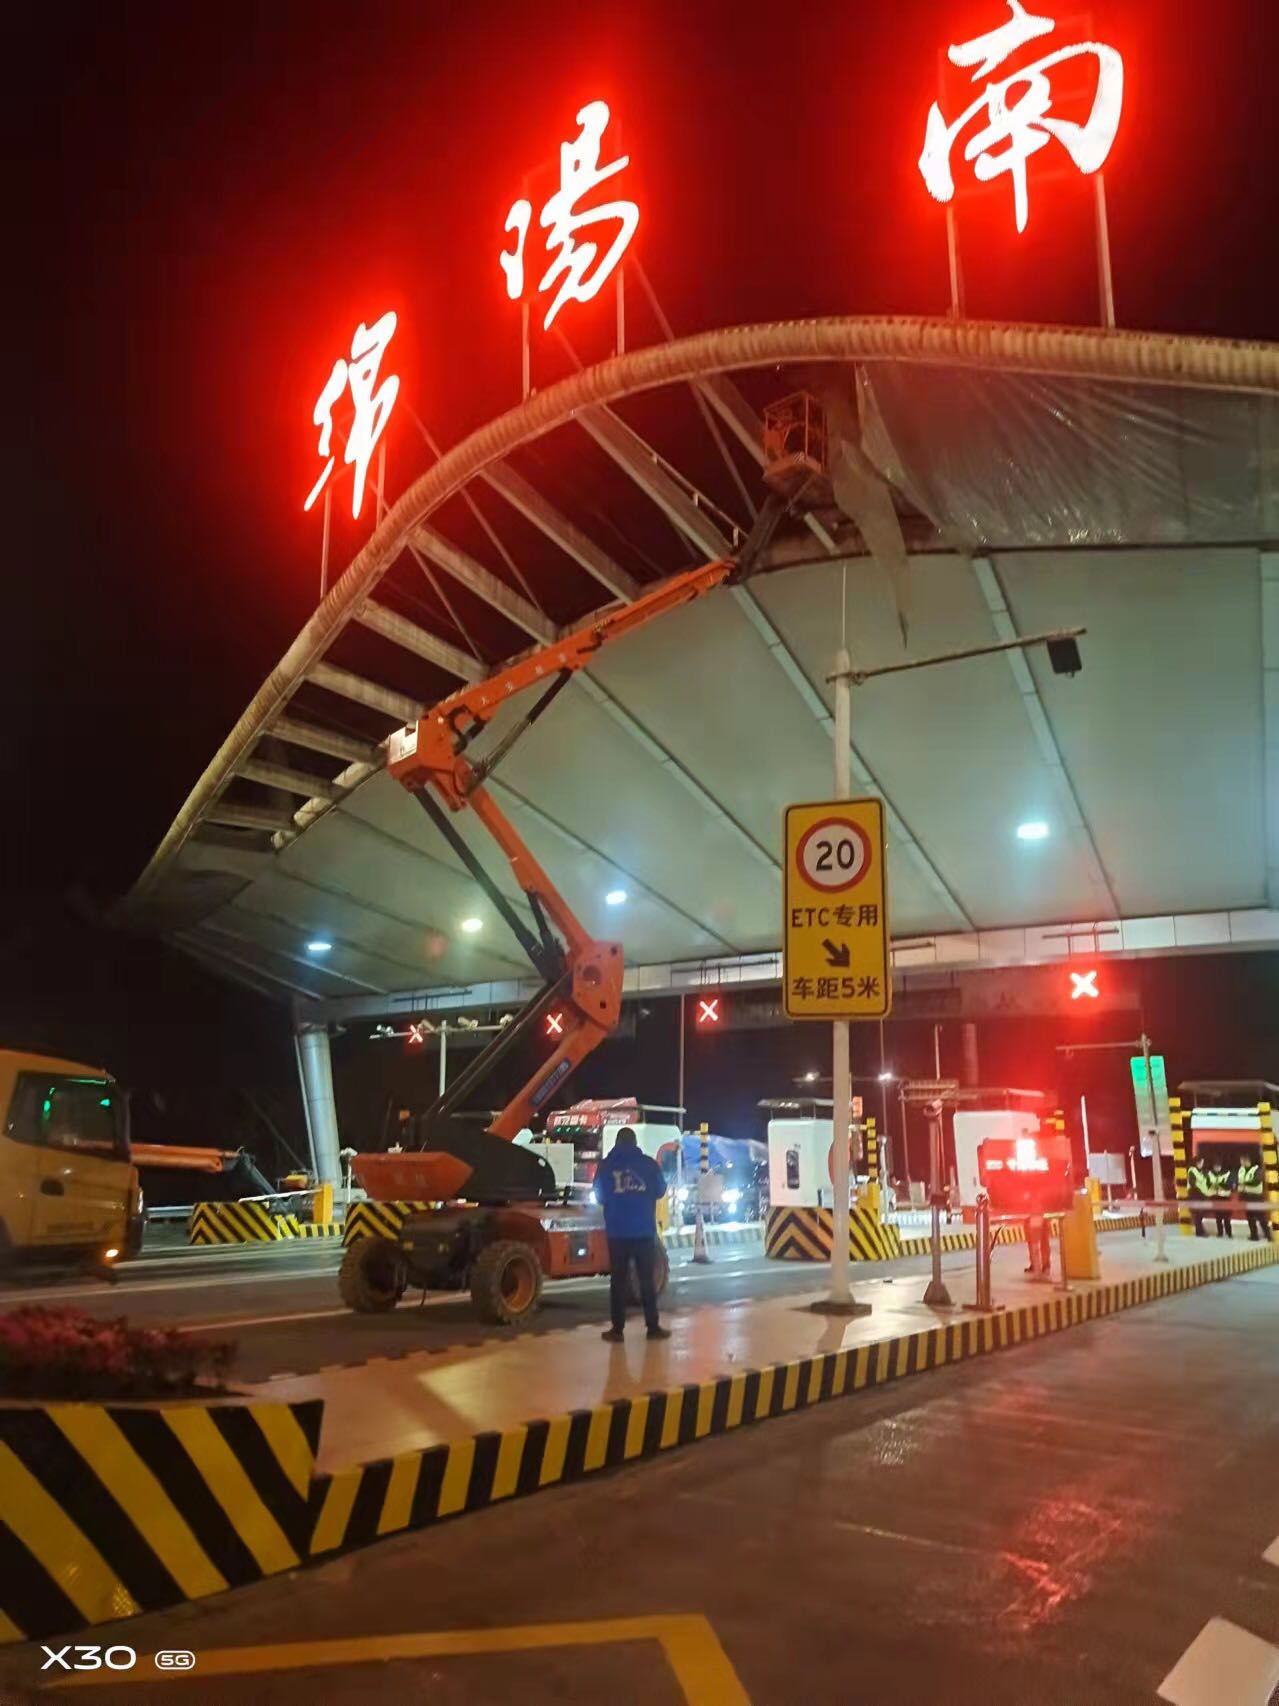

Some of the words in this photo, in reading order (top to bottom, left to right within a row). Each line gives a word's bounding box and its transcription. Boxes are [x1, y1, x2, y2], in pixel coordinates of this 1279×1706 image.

[815, 838, 855, 872] 20
[791, 903, 879, 929] ETC专用
[791, 976, 881, 1001] 车距5米
